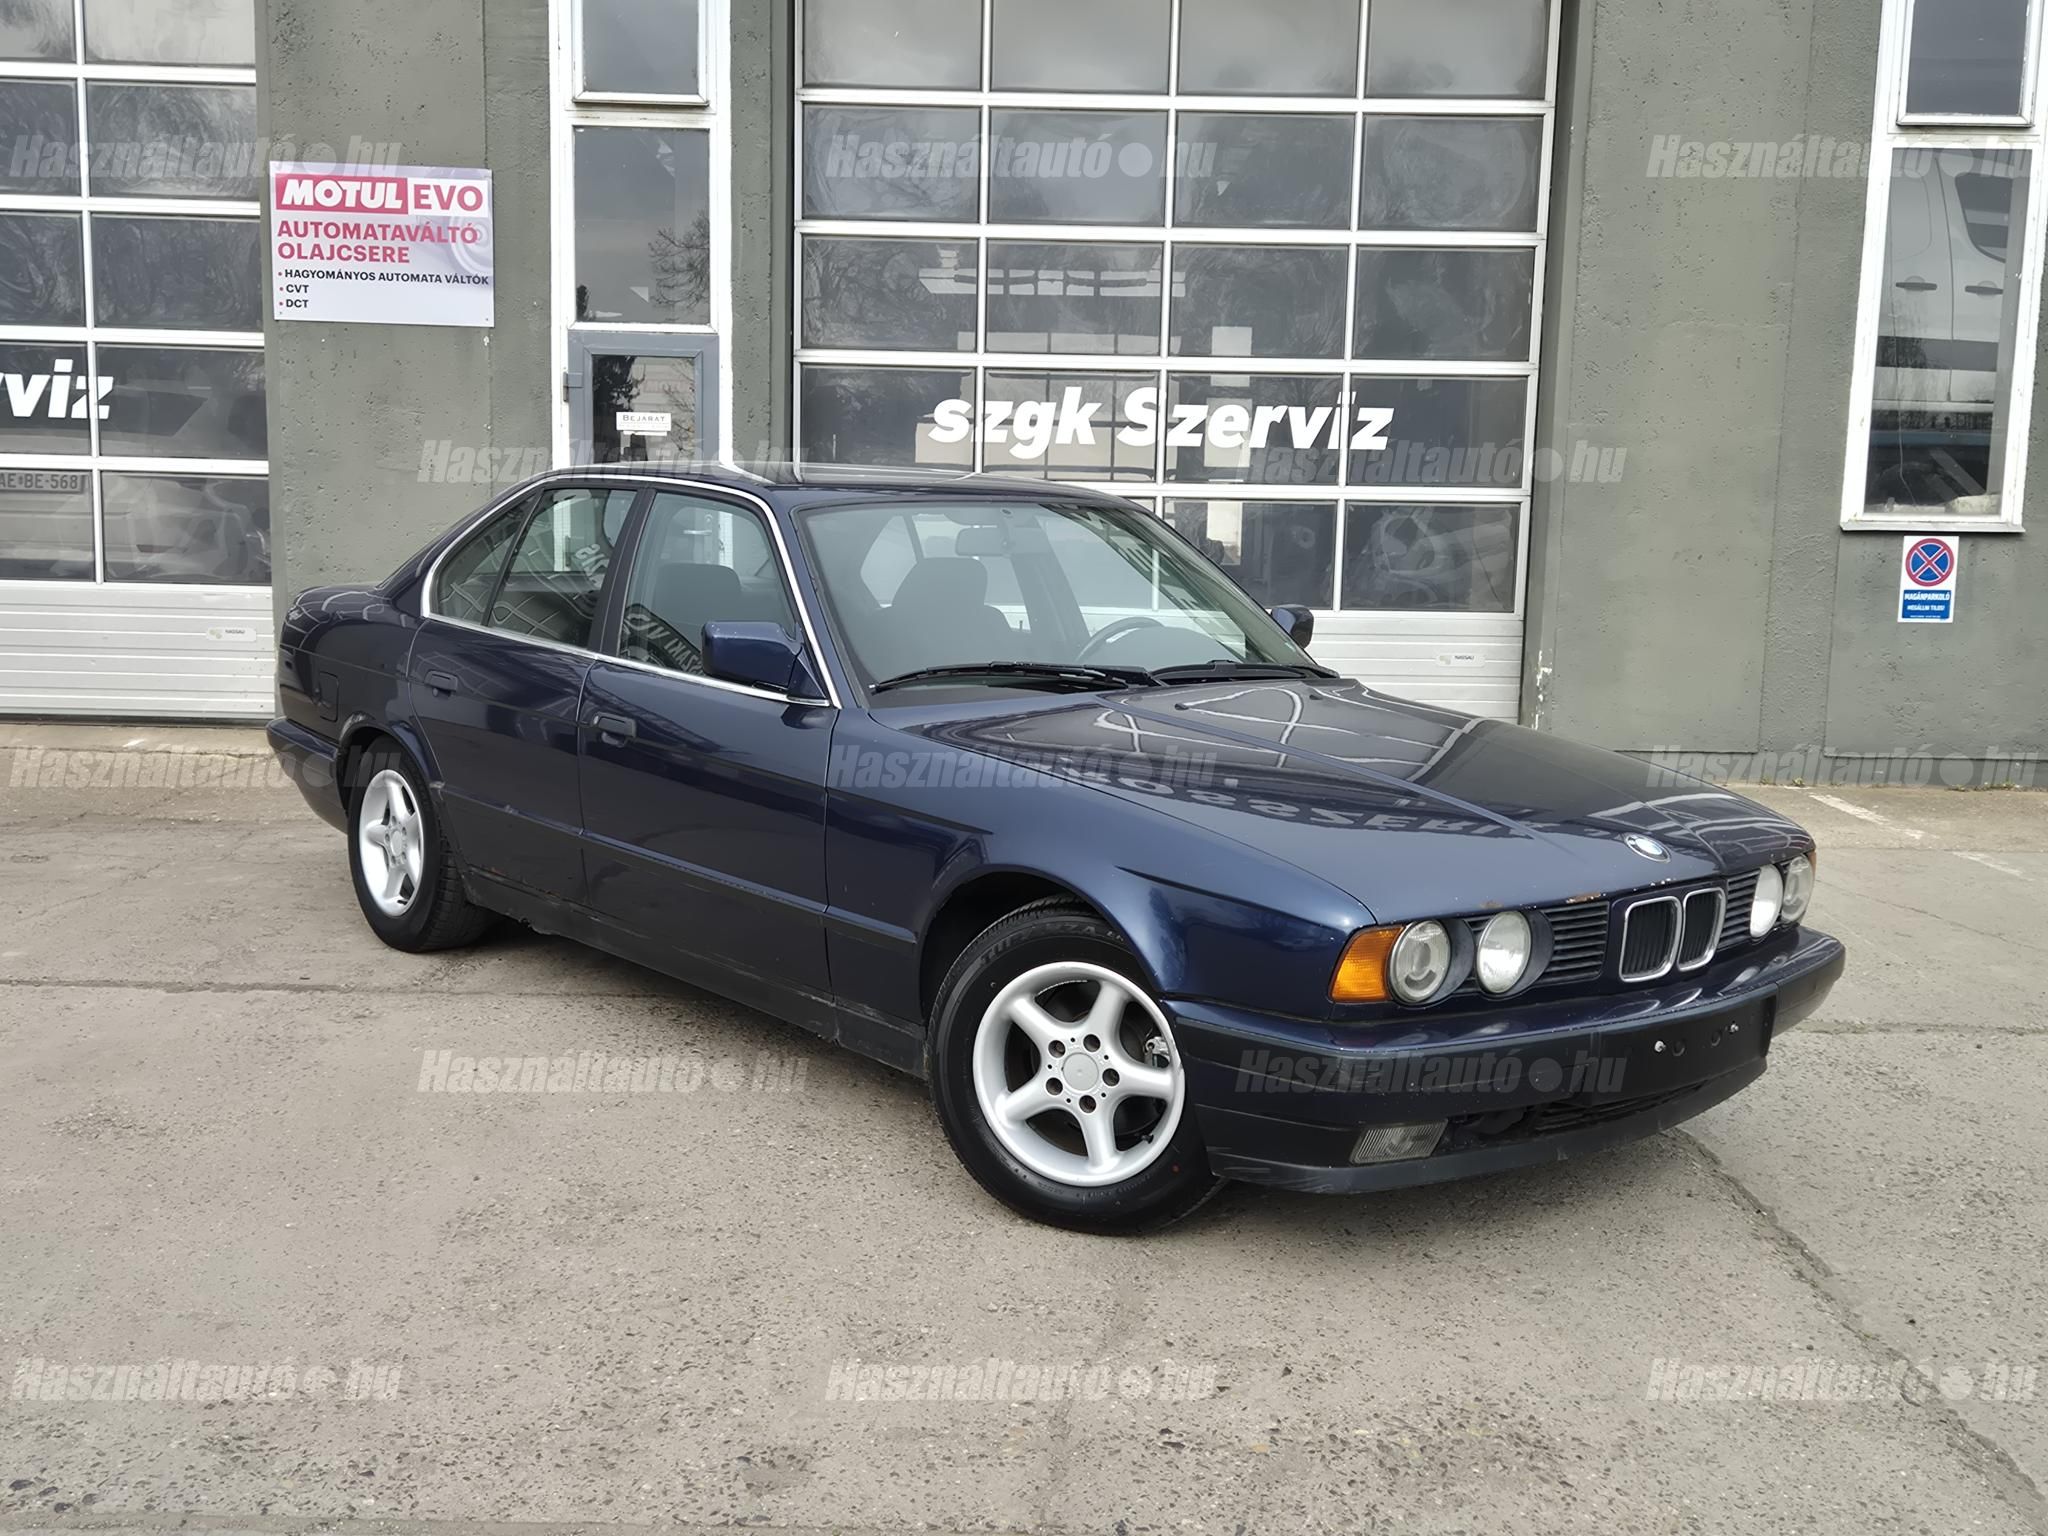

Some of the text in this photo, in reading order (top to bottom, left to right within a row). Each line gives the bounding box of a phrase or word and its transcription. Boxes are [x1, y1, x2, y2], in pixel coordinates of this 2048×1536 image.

[281, 179, 483, 212] MOTUL EVO
[277, 220, 478, 244] AUTOMATAVÁLTÓ
[278, 242, 410, 263] OLAJCSERE
[284, 268, 489, 285] HAGYOMÁNYOS AUTOMATA VÁLTÓK
[286, 284, 309, 293] CVT
[286, 299, 309, 308] DCT
[0, 359, 114, 420] viz
[928, 386, 1395, 460] szgk Szerviz
